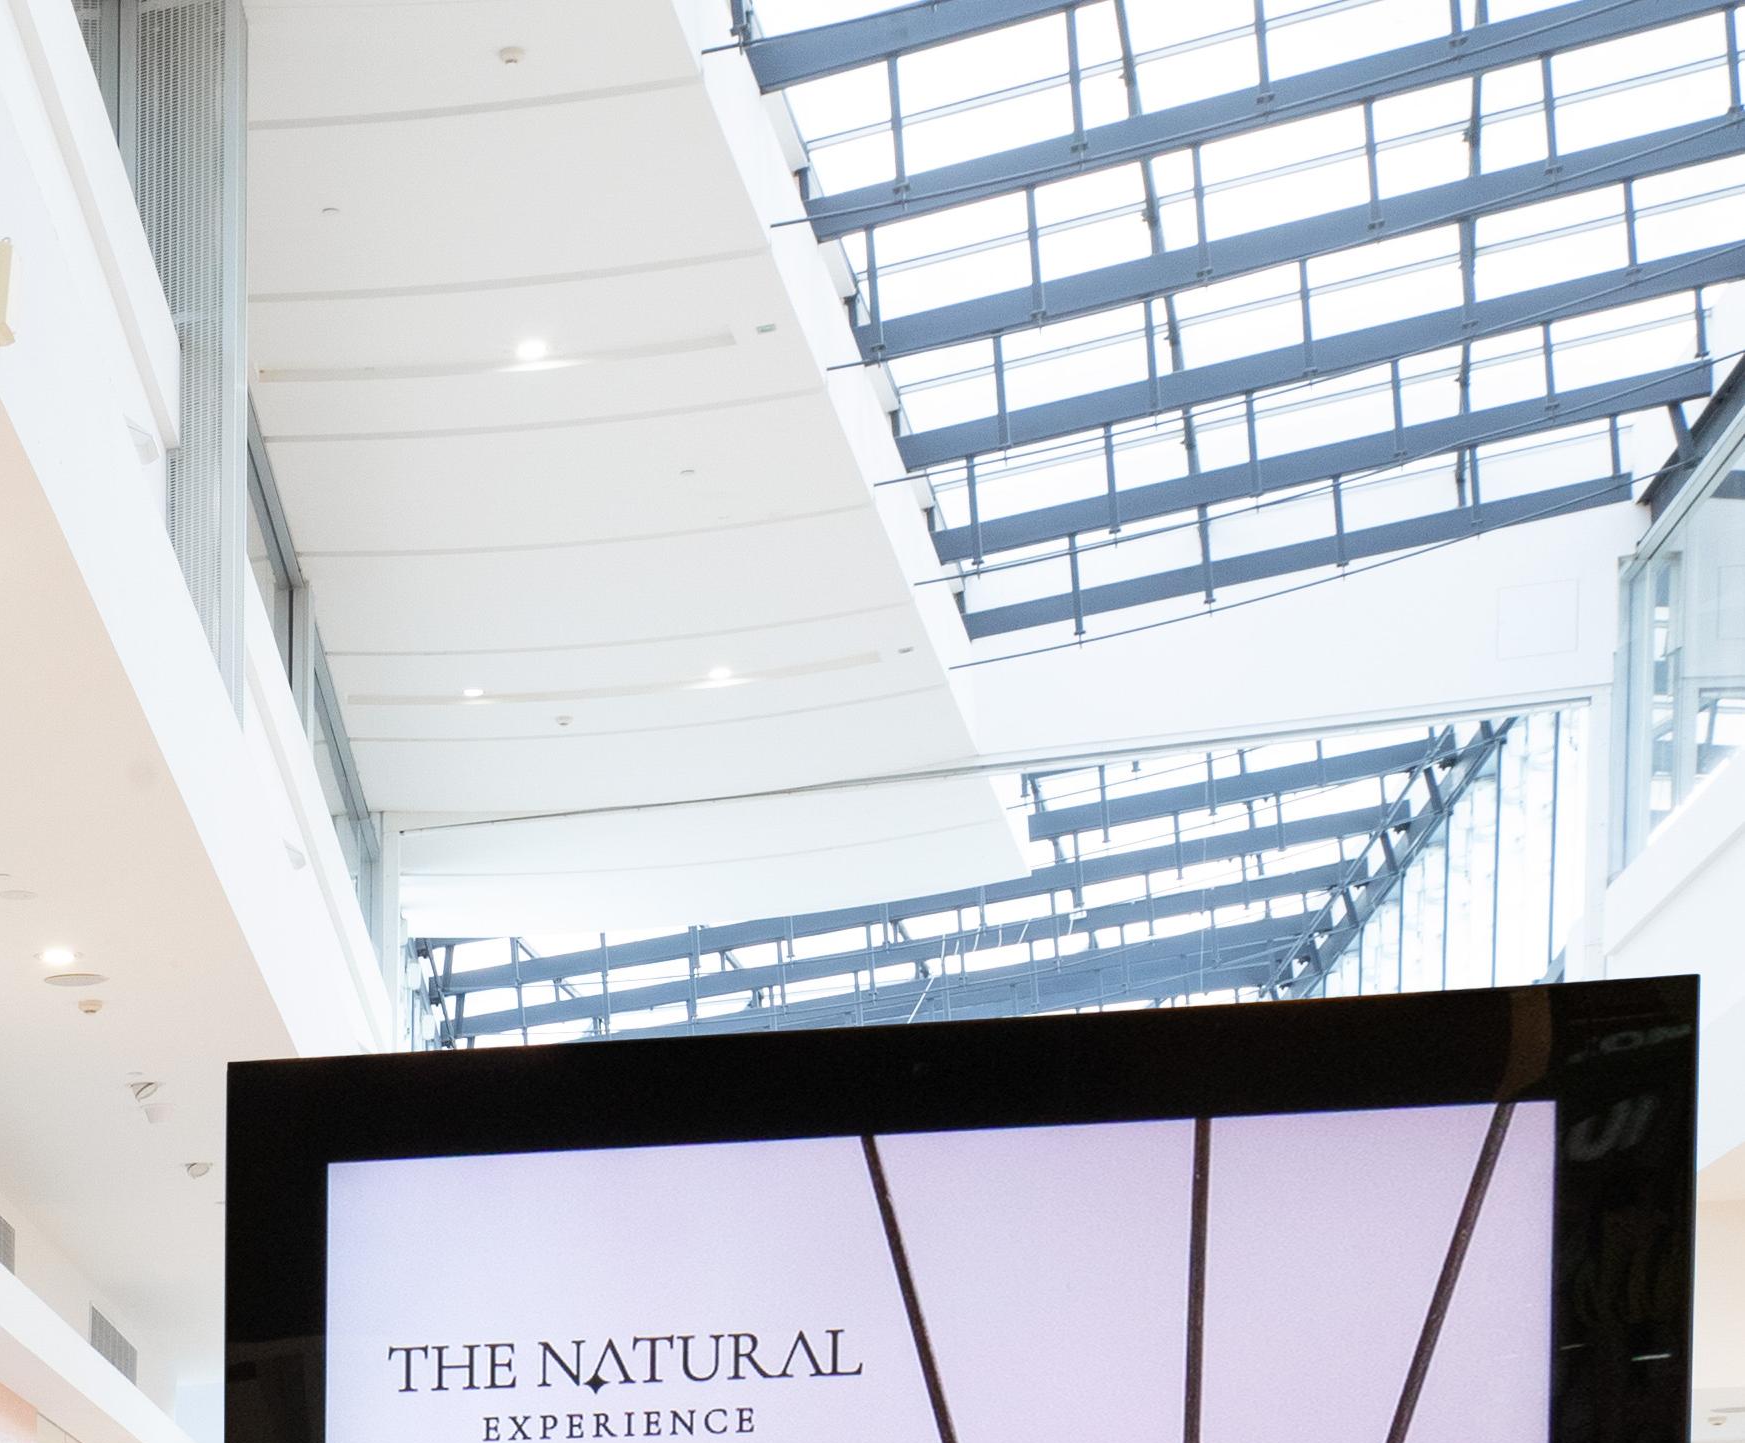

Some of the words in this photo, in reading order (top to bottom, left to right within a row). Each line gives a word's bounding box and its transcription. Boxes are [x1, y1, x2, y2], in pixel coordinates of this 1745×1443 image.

[388, 1343, 517, 1392] THE
[537, 1329, 863, 1394] NATURAL
[483, 1408, 755, 1441] EXPERIENCE
